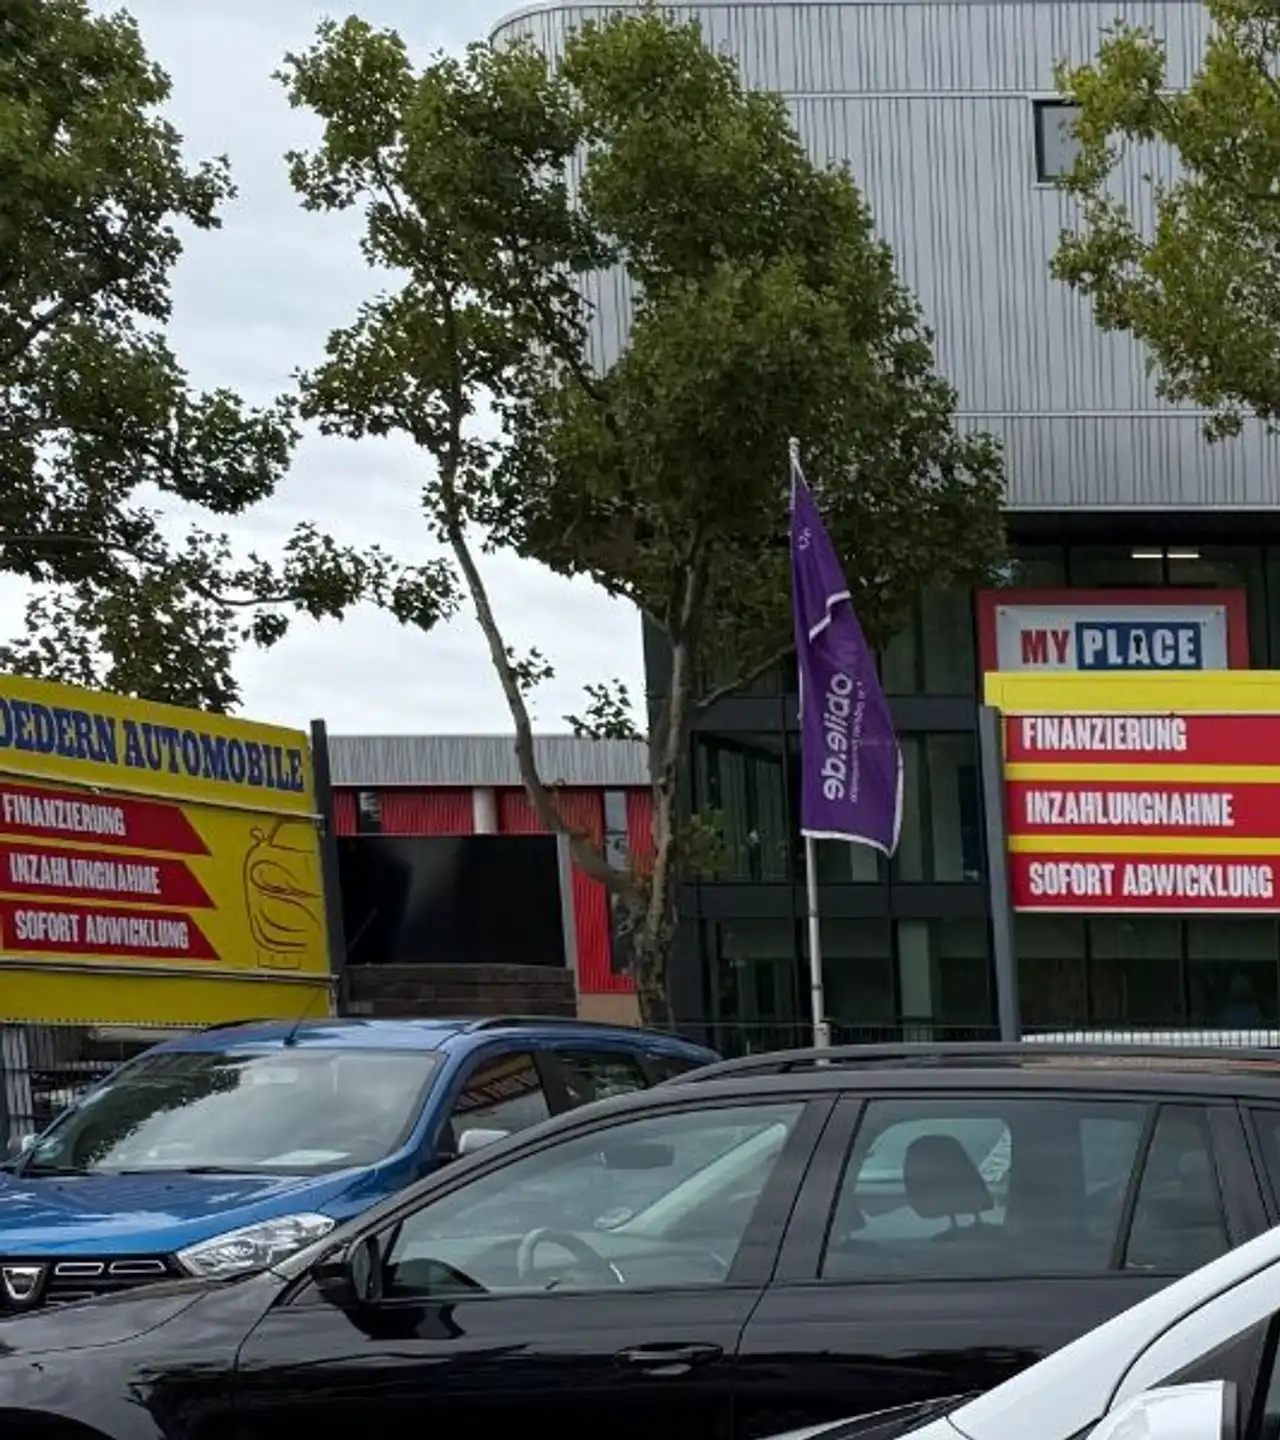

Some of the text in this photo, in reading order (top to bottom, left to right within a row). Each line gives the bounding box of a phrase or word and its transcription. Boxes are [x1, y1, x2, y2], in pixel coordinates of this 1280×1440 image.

[1021, 628, 1197, 667] MY PLACE
[1022, 717, 1188, 750] FINANZIERUNG
[123, 720, 305, 792] AUTOMOBILE
[2, 792, 127, 836] FINANZIERUNG
[1025, 791, 1235, 826] INZAHLUNGNAHME
[9, 853, 162, 894] INZAHLUNGNAHME
[1029, 861, 1275, 898] SOFORT ABWICKLUNG
[14, 909, 190, 950] SOFORT ABWICKLUNG
